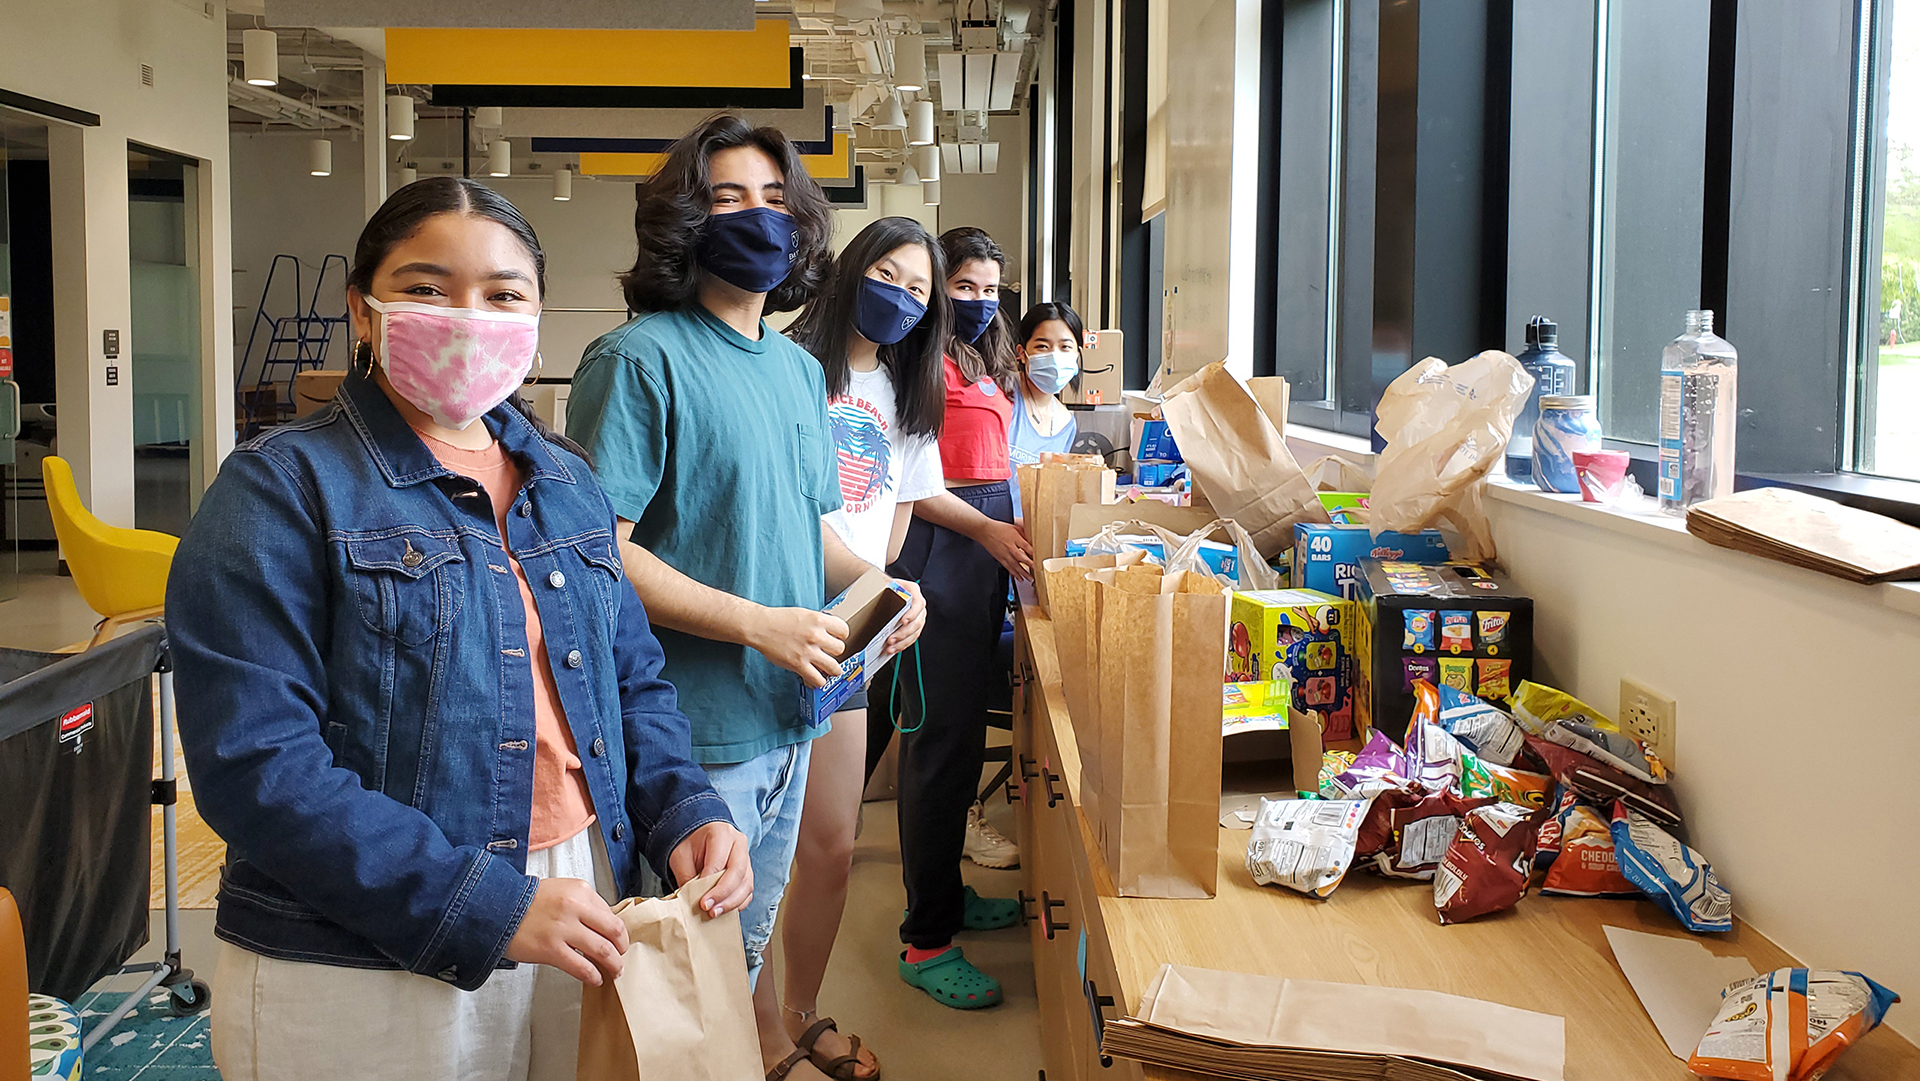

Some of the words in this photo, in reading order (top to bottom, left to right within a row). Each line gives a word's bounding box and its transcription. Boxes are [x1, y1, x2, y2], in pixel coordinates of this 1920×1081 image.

[856, 397, 889, 431] BEACH
[1310, 536, 1332, 552] 40
[1370, 546, 1404, 560] Kellogg's
[1482, 617, 1505, 632] Fritos
[1581, 849, 1615, 864] CHEDD
